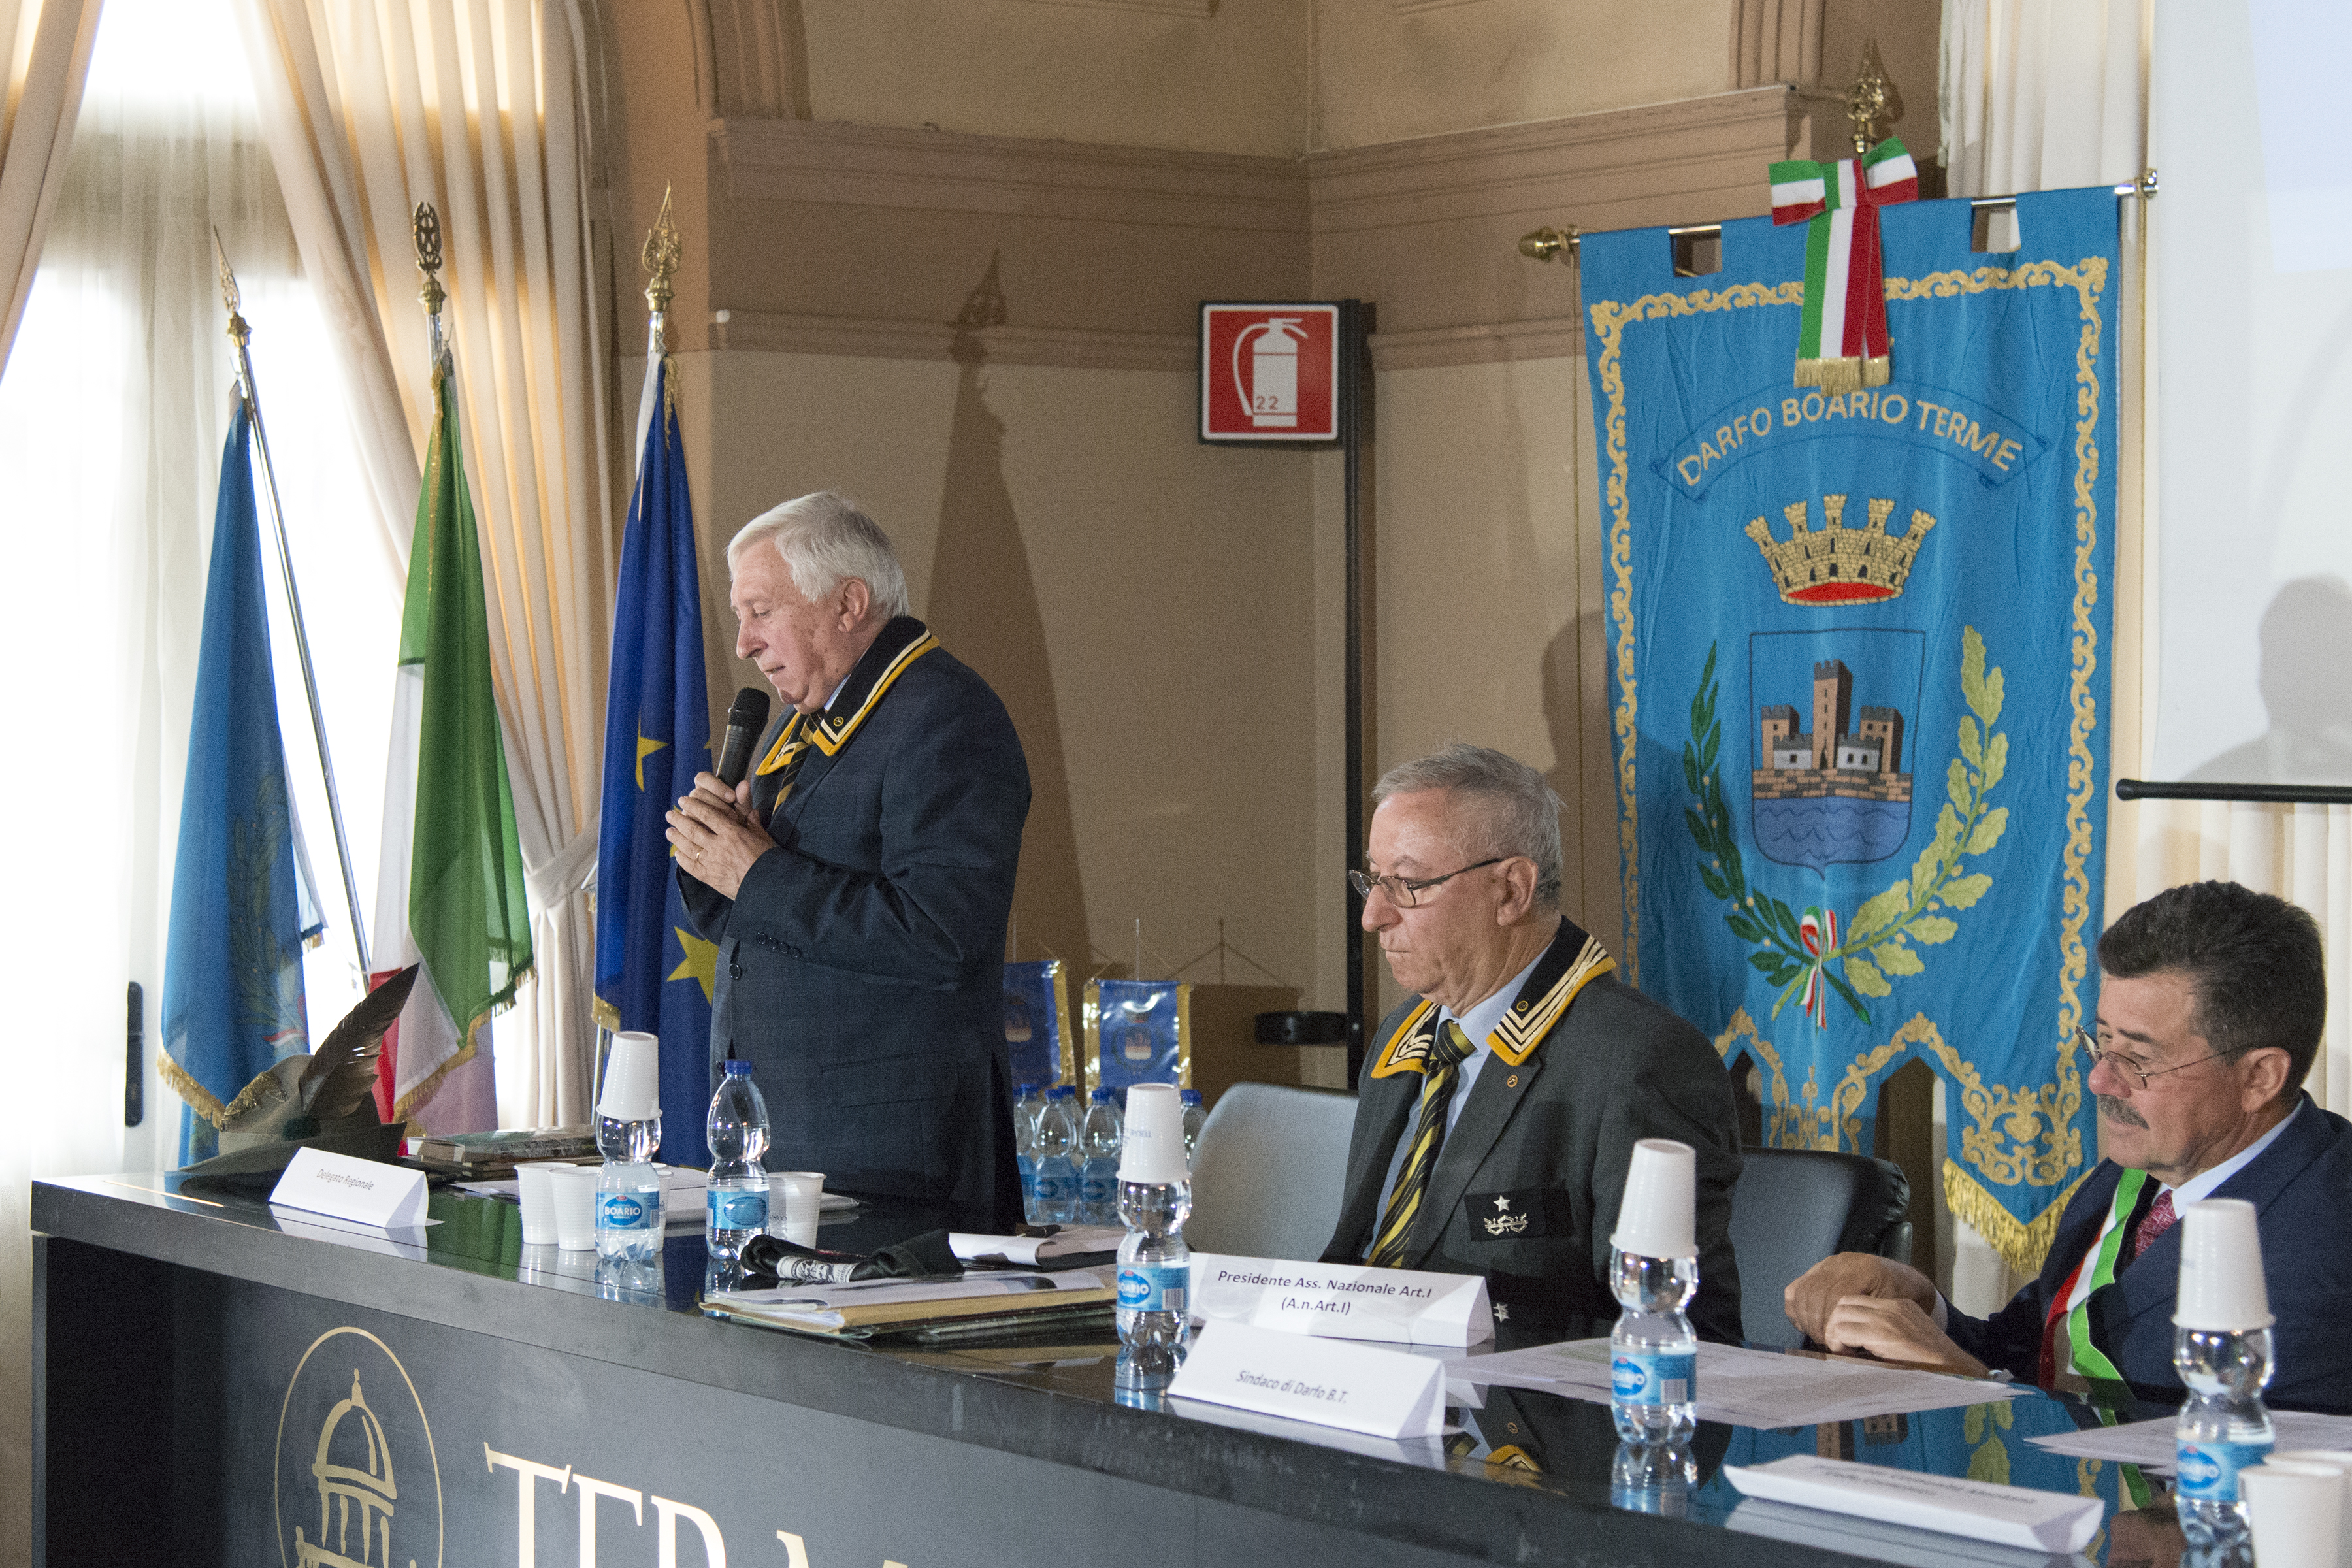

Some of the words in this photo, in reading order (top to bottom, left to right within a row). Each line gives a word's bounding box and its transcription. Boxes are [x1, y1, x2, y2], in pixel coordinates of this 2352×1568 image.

[1256, 396, 1279, 410] 22
[1677, 407, 1772, 485] DARFO
[1782, 391, 1908, 427] BOARIO
[1916, 399, 2023, 471] TERME
[317, 1169, 344, 1183] Delegato
[343, 1175, 374, 1190] Regionale
[604, 1206, 640, 1215] BOARIO
[1218, 1271, 1291, 1287] Presidente
[1294, 1277, 1321, 1289] Ass.
[1326, 1279, 1396, 1296] Nazionale
[1399, 1286, 1432, 1298] Art.I
[1281, 1296, 1351, 1316] (A.n.Art.I)
[1236, 1370, 1279, 1389] Sindaco
[1281, 1380, 1295, 1392] di
[1294, 1382, 1325, 1399] Darfo
[1326, 1388, 1348, 1404] B.T.
